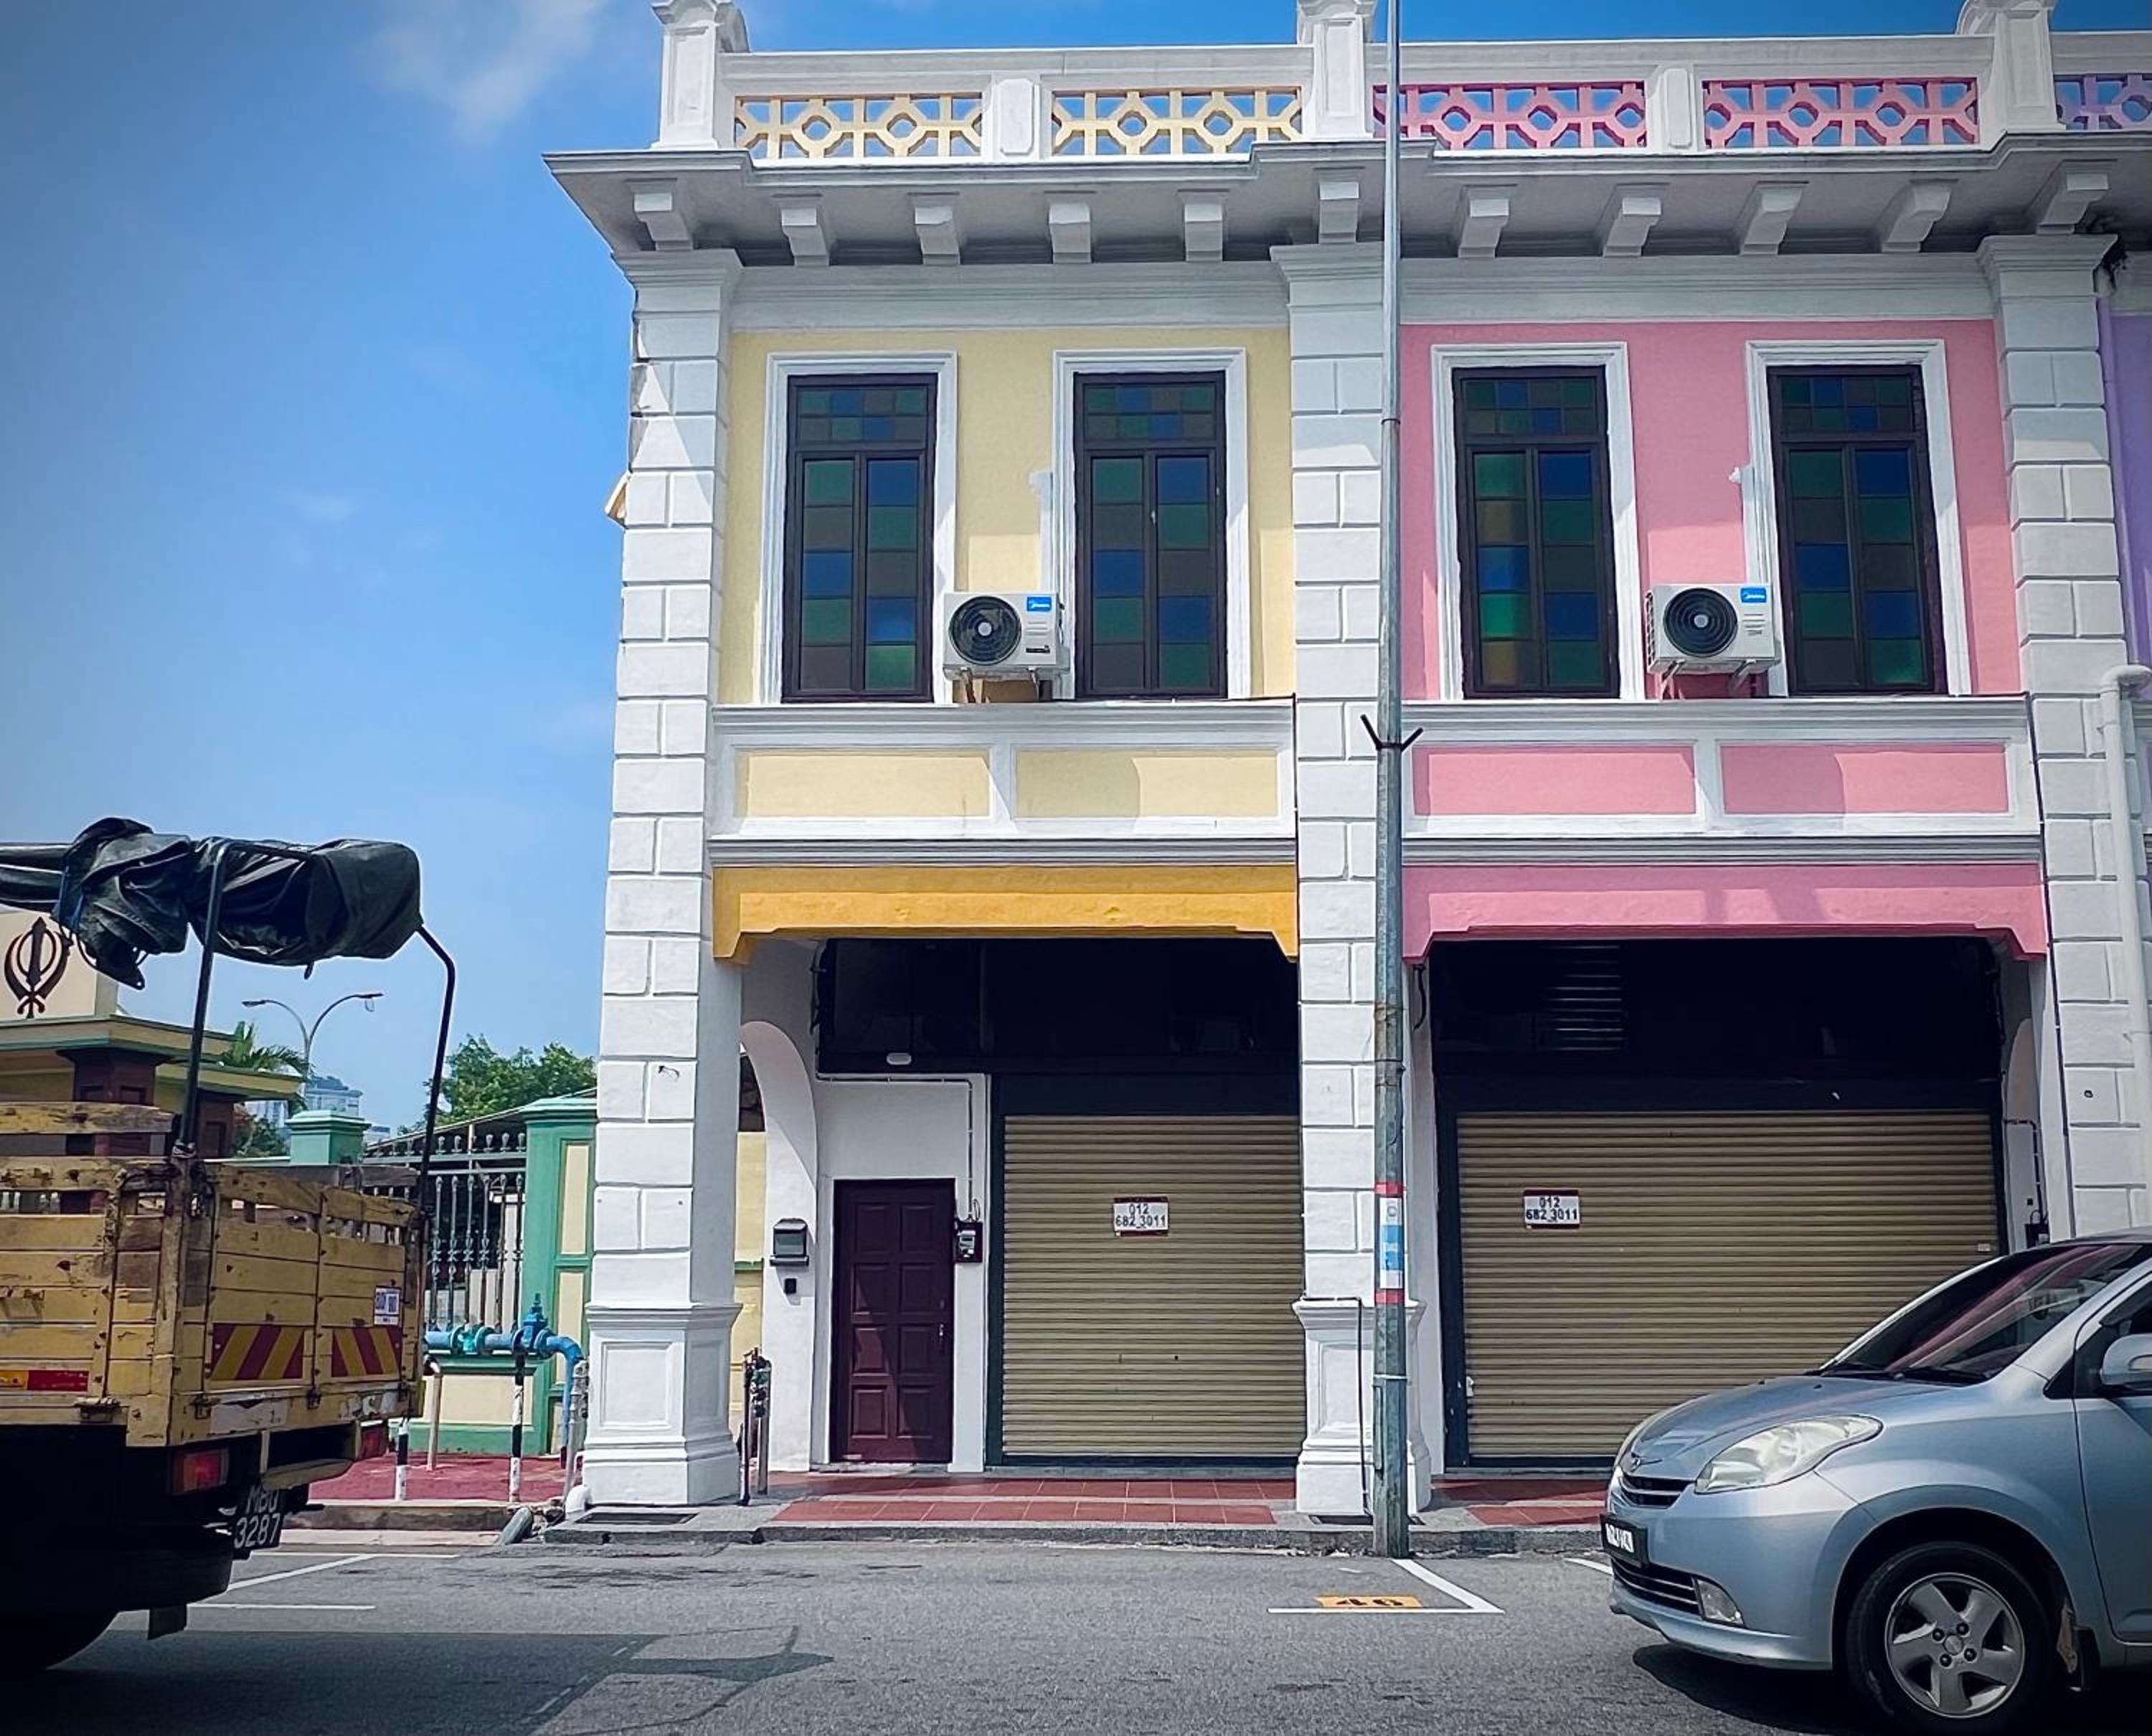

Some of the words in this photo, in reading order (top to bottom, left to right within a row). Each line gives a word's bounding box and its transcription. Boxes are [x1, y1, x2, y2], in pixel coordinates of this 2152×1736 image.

[1129, 1204, 1149, 1214] 012
[1539, 1197, 1559, 1208] 012
[1115, 1214, 1136, 1227] 682
[1140, 1214, 1166, 1227] 3011
[1526, 1209, 1547, 1220] 682
[1550, 1208, 1577, 1221] 3011
[234, 1513, 280, 1549] 3287
